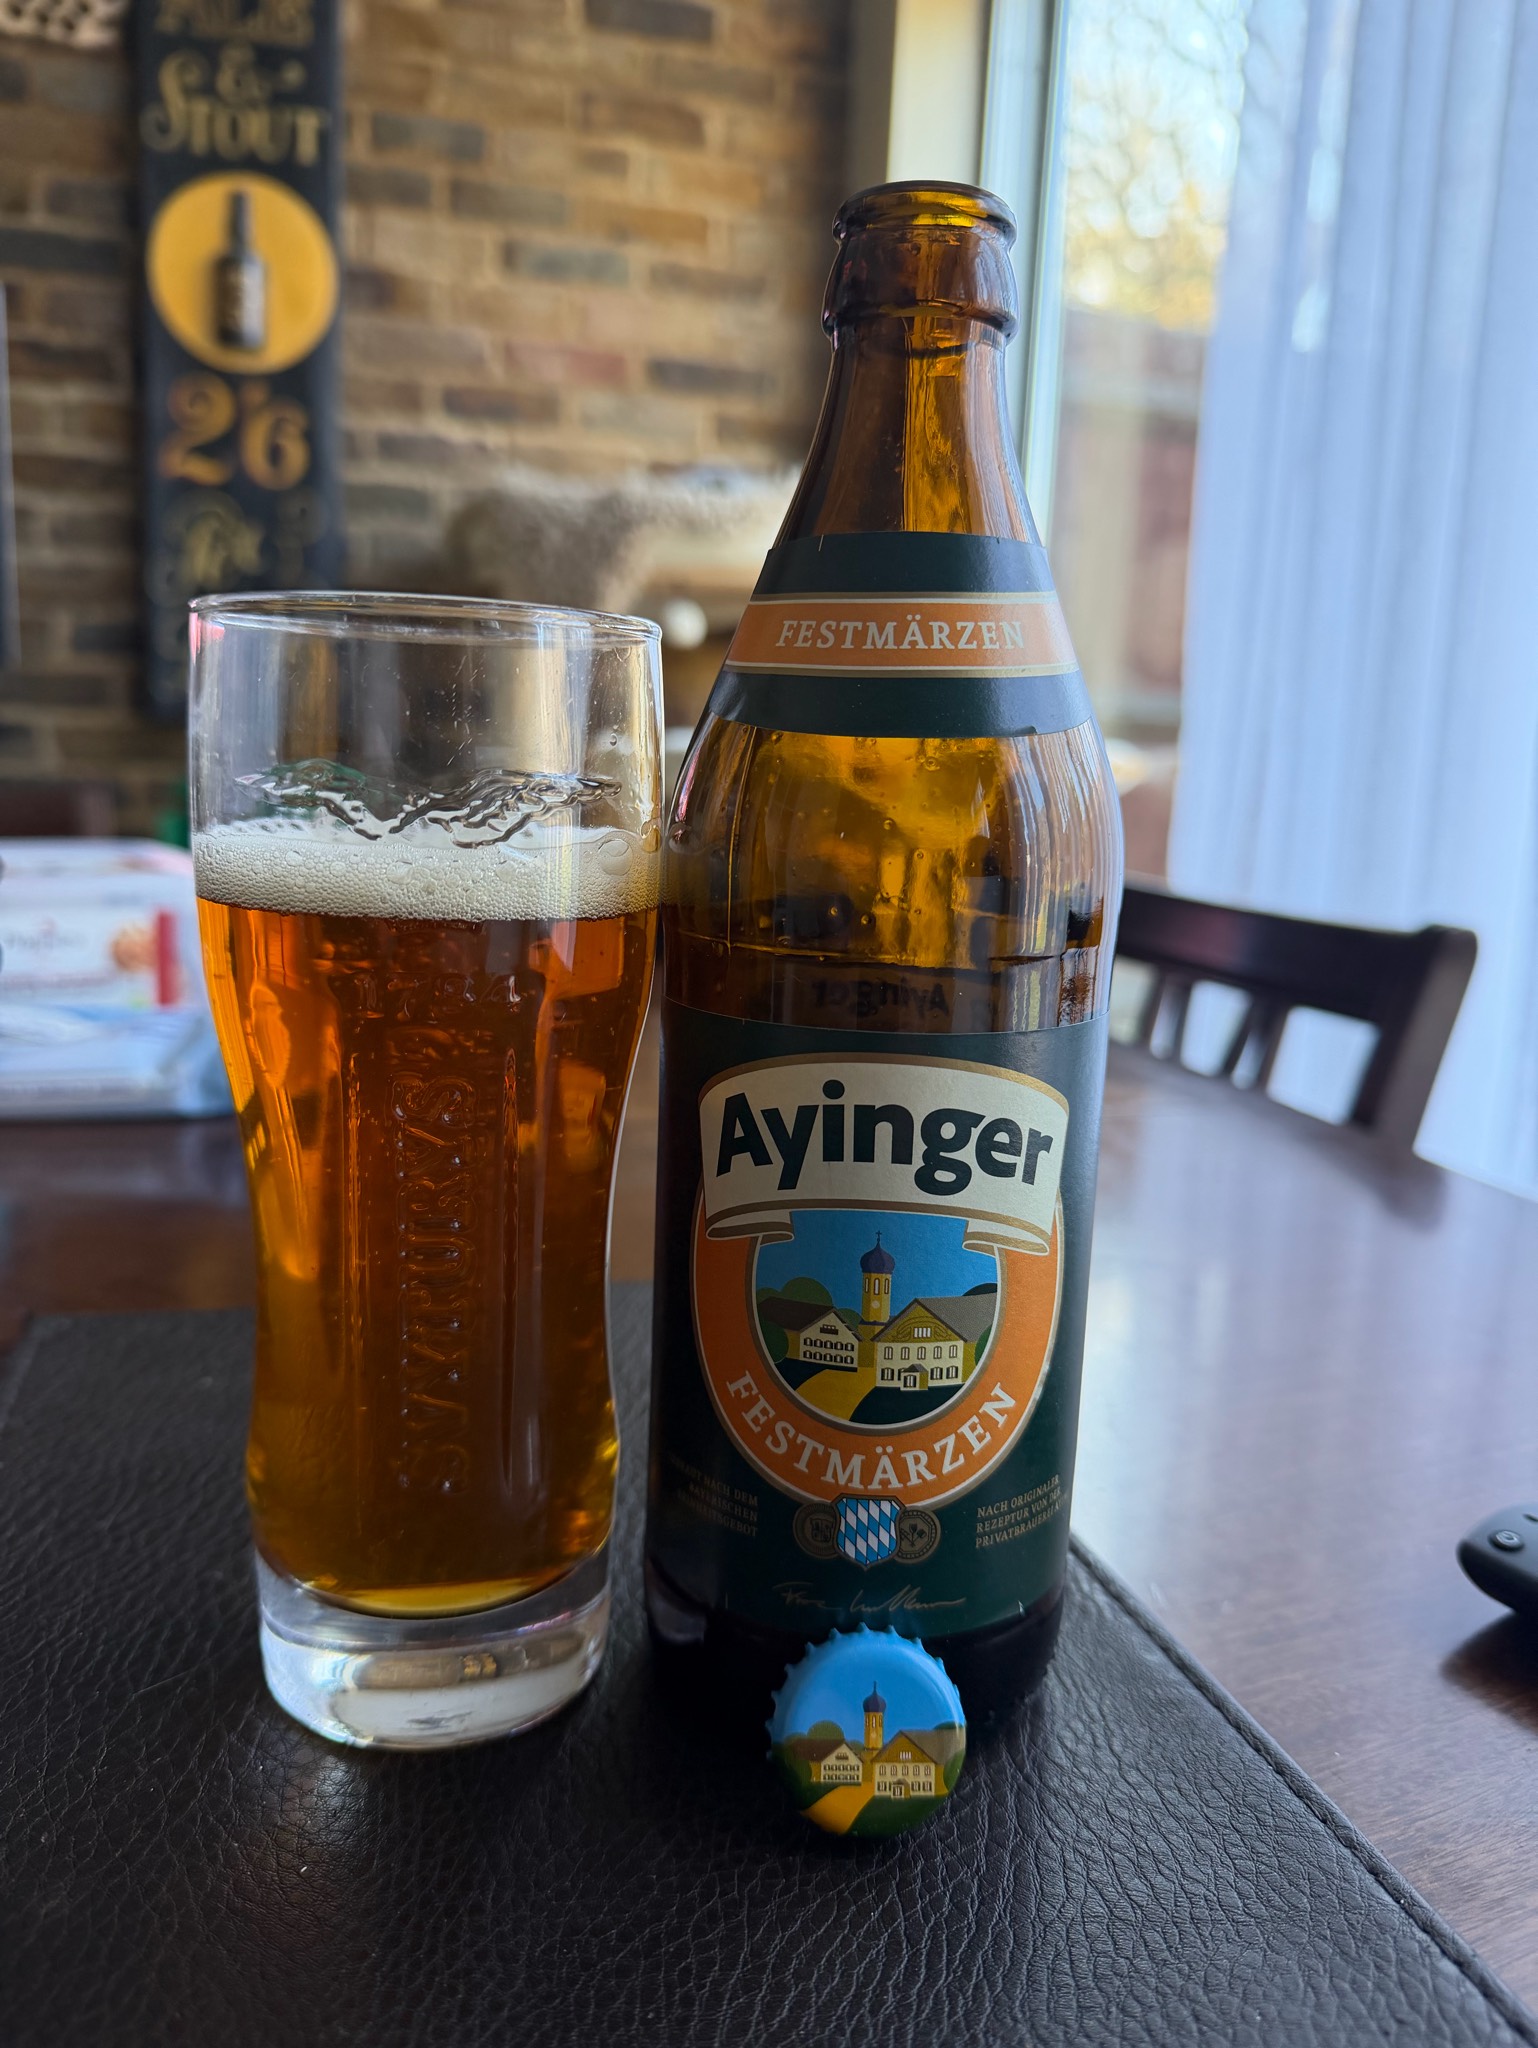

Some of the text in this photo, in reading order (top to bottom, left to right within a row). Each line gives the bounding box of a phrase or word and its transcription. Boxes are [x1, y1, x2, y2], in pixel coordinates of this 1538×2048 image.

[776, 614, 1025, 650] FESTMÄRZEN
[716, 1079, 1054, 1196] Ayinger
[726, 1370, 1017, 1490] FESTMÄRZEN
[976, 1507, 1029, 1533] REZEPTUR
[1031, 1496, 1048, 1513] VON
[977, 1500, 1008, 1518] NACH
[1010, 1474, 1060, 1508] ORIGINALER
